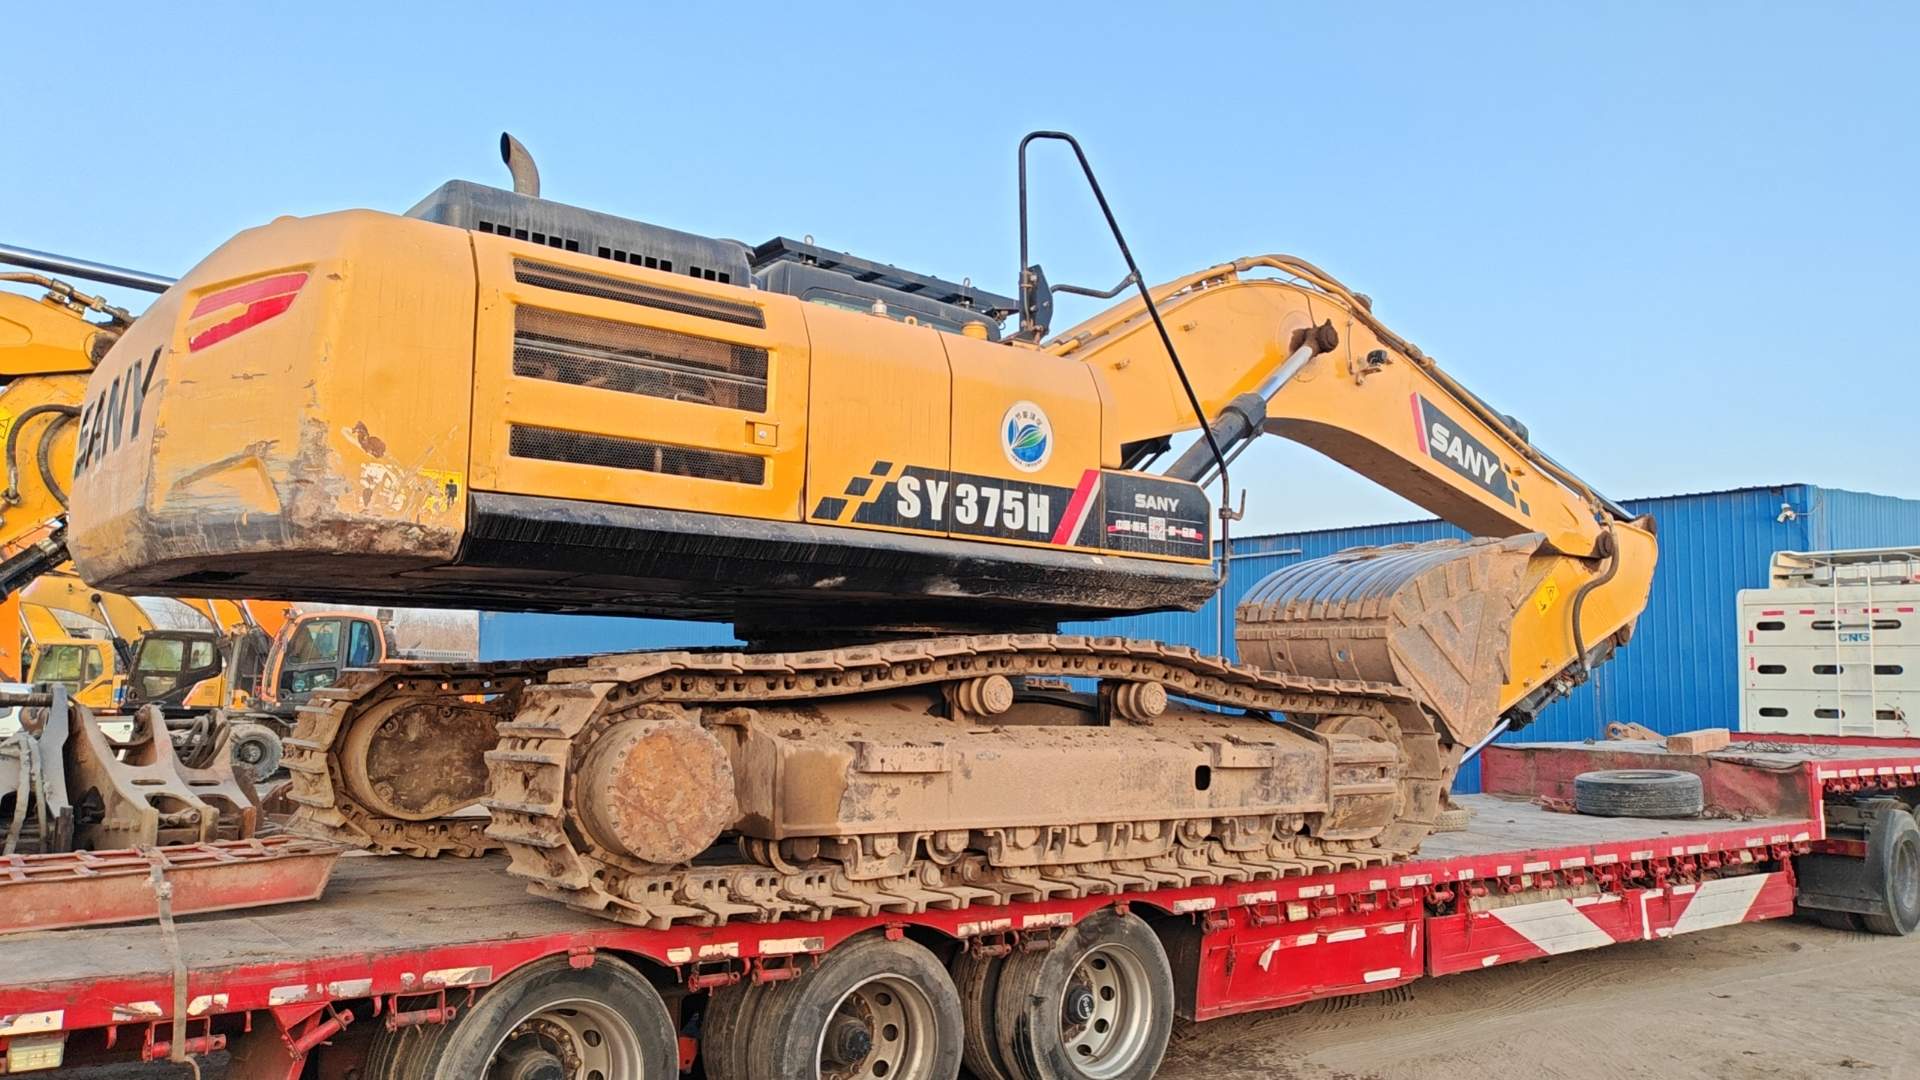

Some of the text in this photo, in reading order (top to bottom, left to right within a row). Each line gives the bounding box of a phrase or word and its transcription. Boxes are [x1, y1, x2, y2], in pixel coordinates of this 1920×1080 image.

[1430, 422, 1499, 485] SANY
[897, 475, 1050, 533] SY375H
[1134, 493, 1180, 513] SANY
[1838, 632, 1871, 642] CNG
